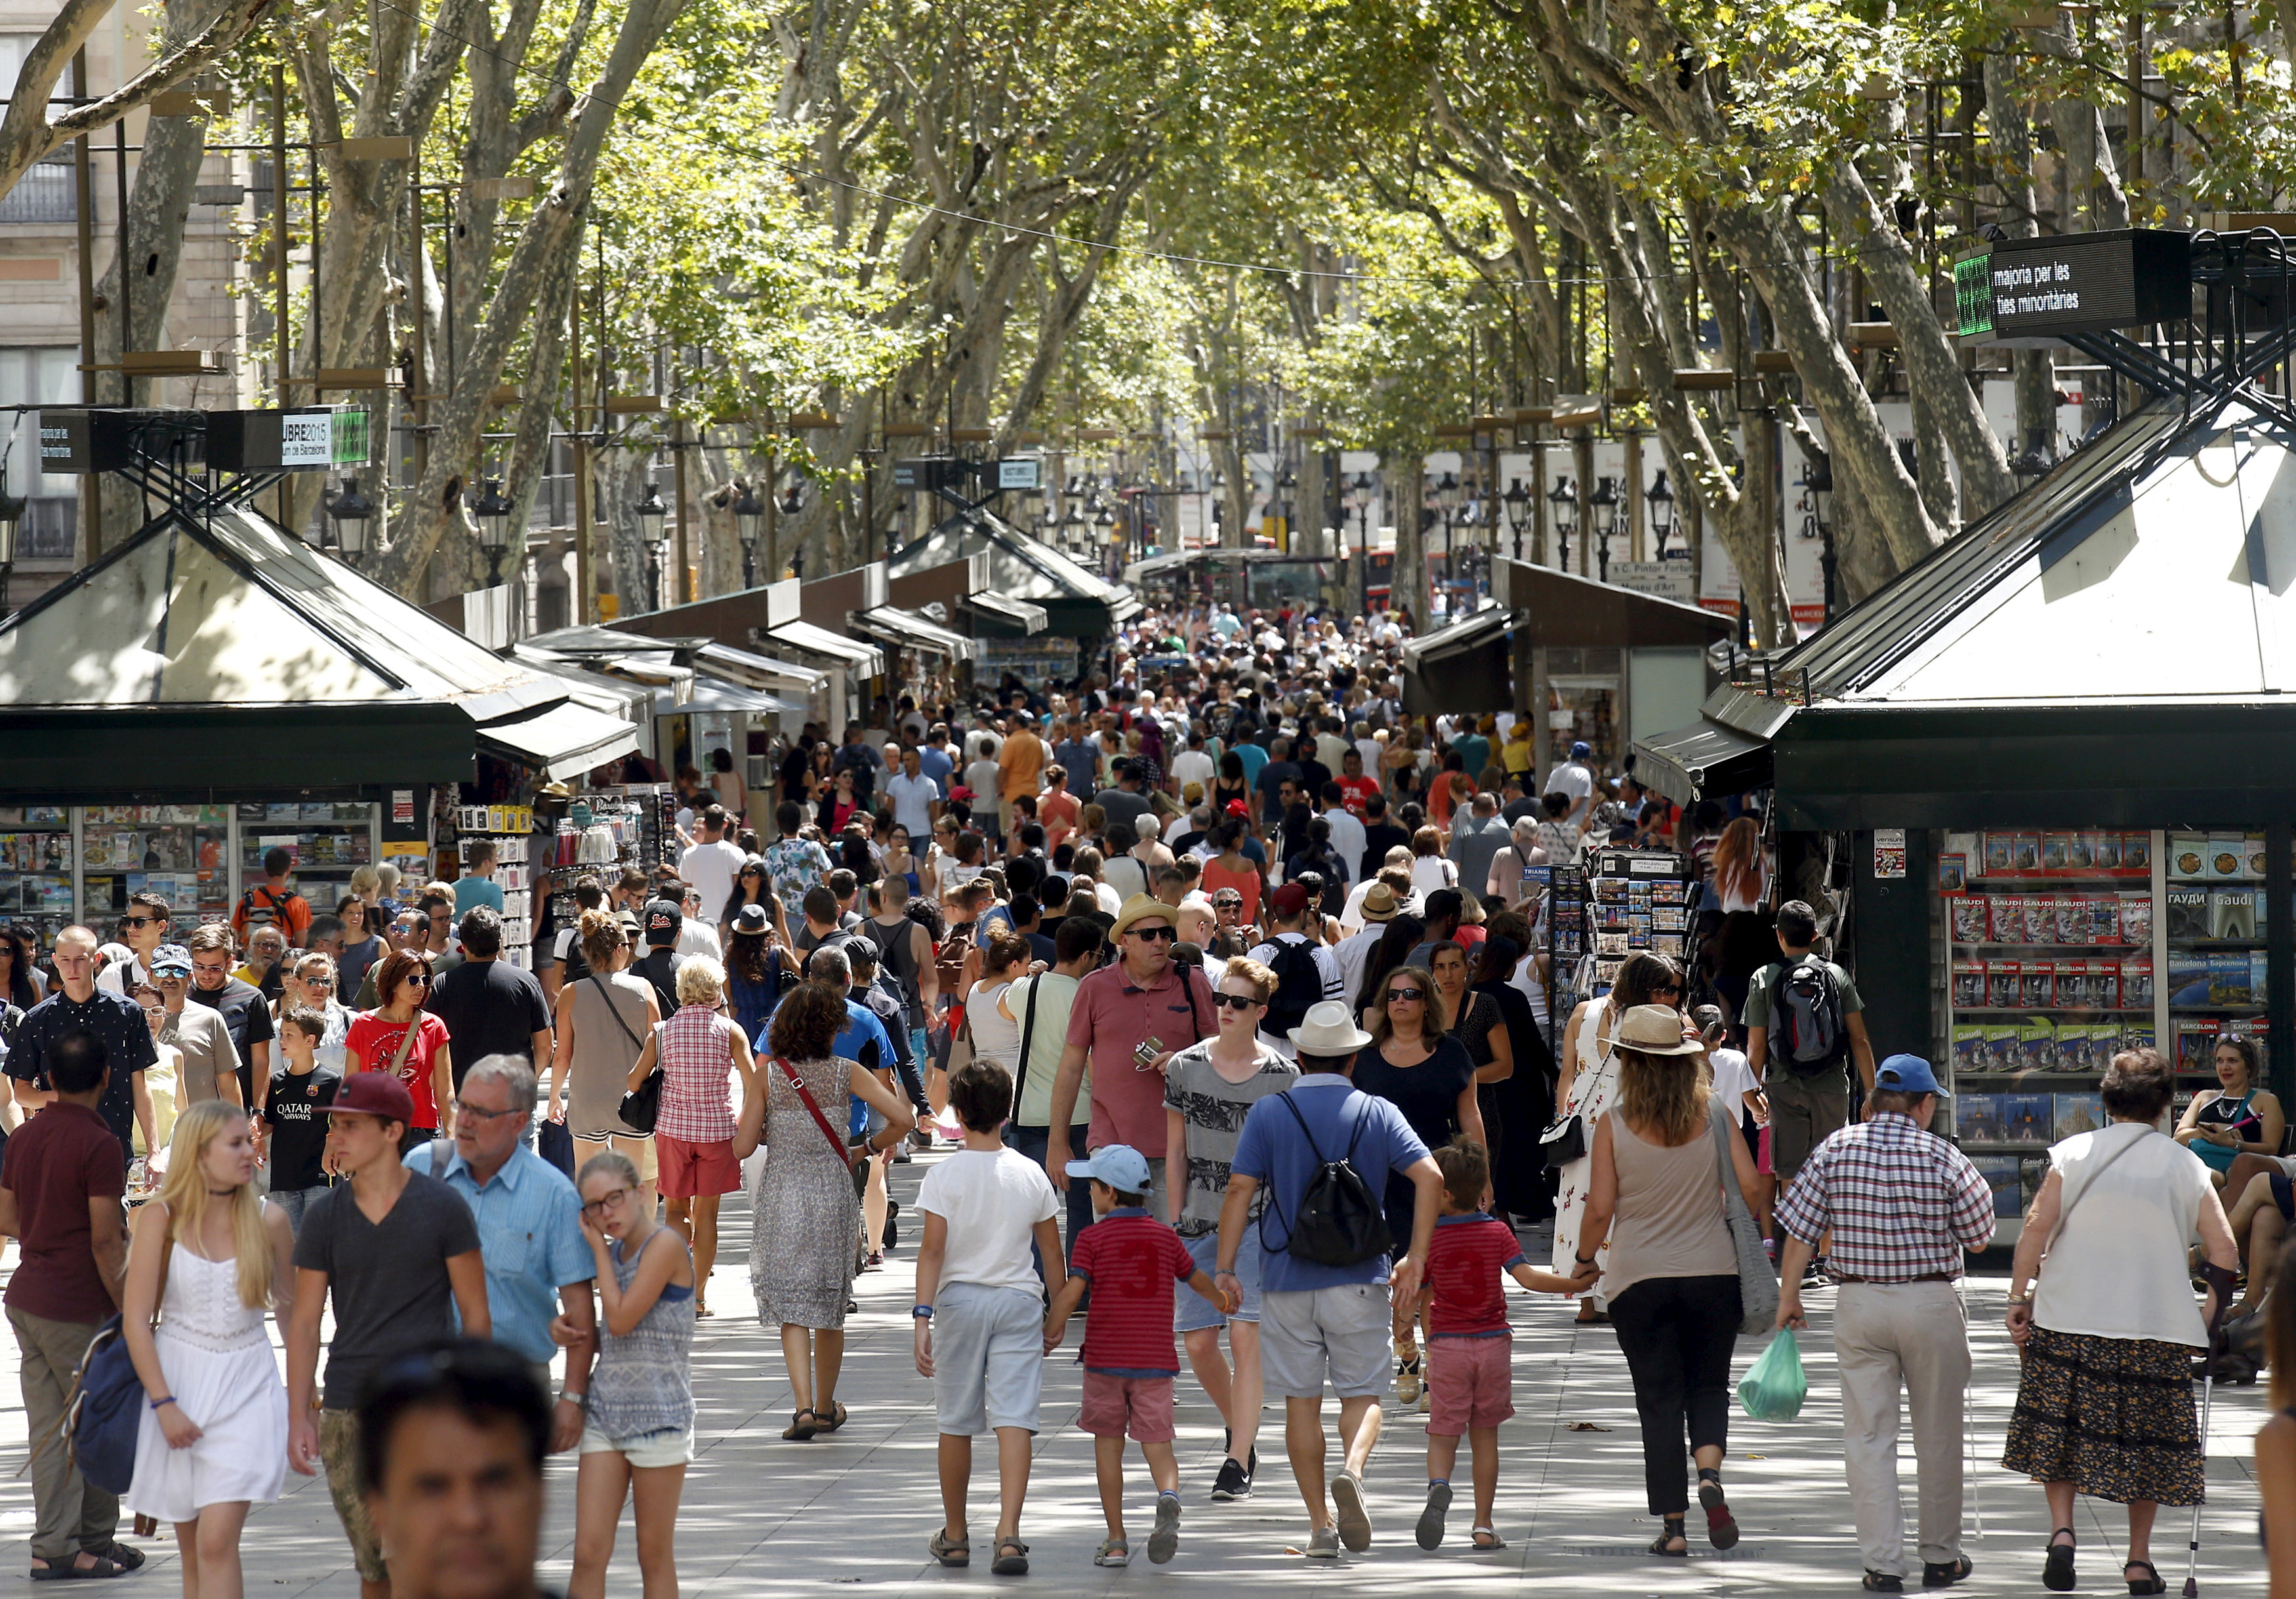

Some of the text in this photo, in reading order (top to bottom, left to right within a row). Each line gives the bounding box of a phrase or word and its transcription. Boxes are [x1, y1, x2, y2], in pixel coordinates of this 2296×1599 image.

[2034, 266, 2051, 289] per
[2054, 260, 2070, 281] les
[1635, 564, 1661, 573] Pintor
[1665, 563, 1693, 572] Fortun
[2168, 893, 2205, 905] ГАУДИ
[2216, 893, 2252, 905] Gaudí
[2210, 960, 2247, 968] Барселона
[277, 1103, 312, 1116] QATAR
[1119, 1239, 1159, 1299] 3
